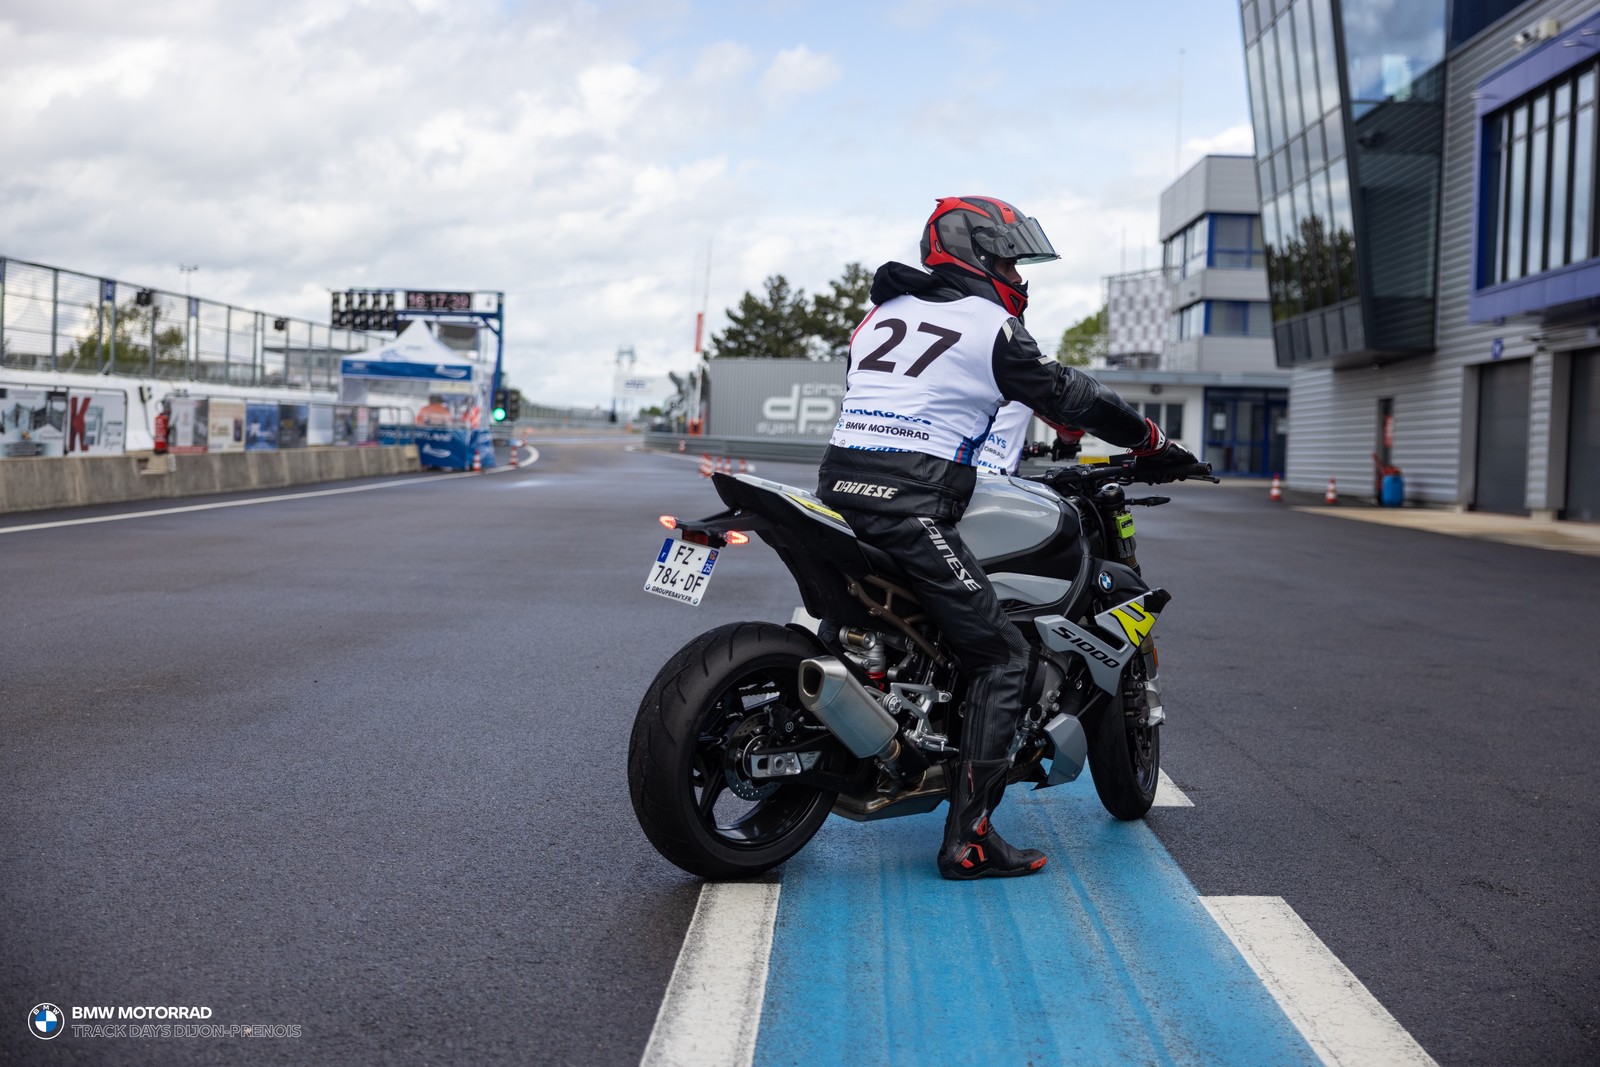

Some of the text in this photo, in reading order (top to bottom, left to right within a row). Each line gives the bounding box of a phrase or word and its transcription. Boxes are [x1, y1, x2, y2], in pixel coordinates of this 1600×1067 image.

[857, 318, 963, 378] 27
[845, 421, 867, 430] BMW
[868, 423, 930, 441] MOTORRAD
[833, 480, 898, 500] DAINESE
[653, 564, 705, 593] 784-DF
[651, 586, 692, 602] GROUPESAVY.FR
[1051, 626, 1120, 669] S1000
